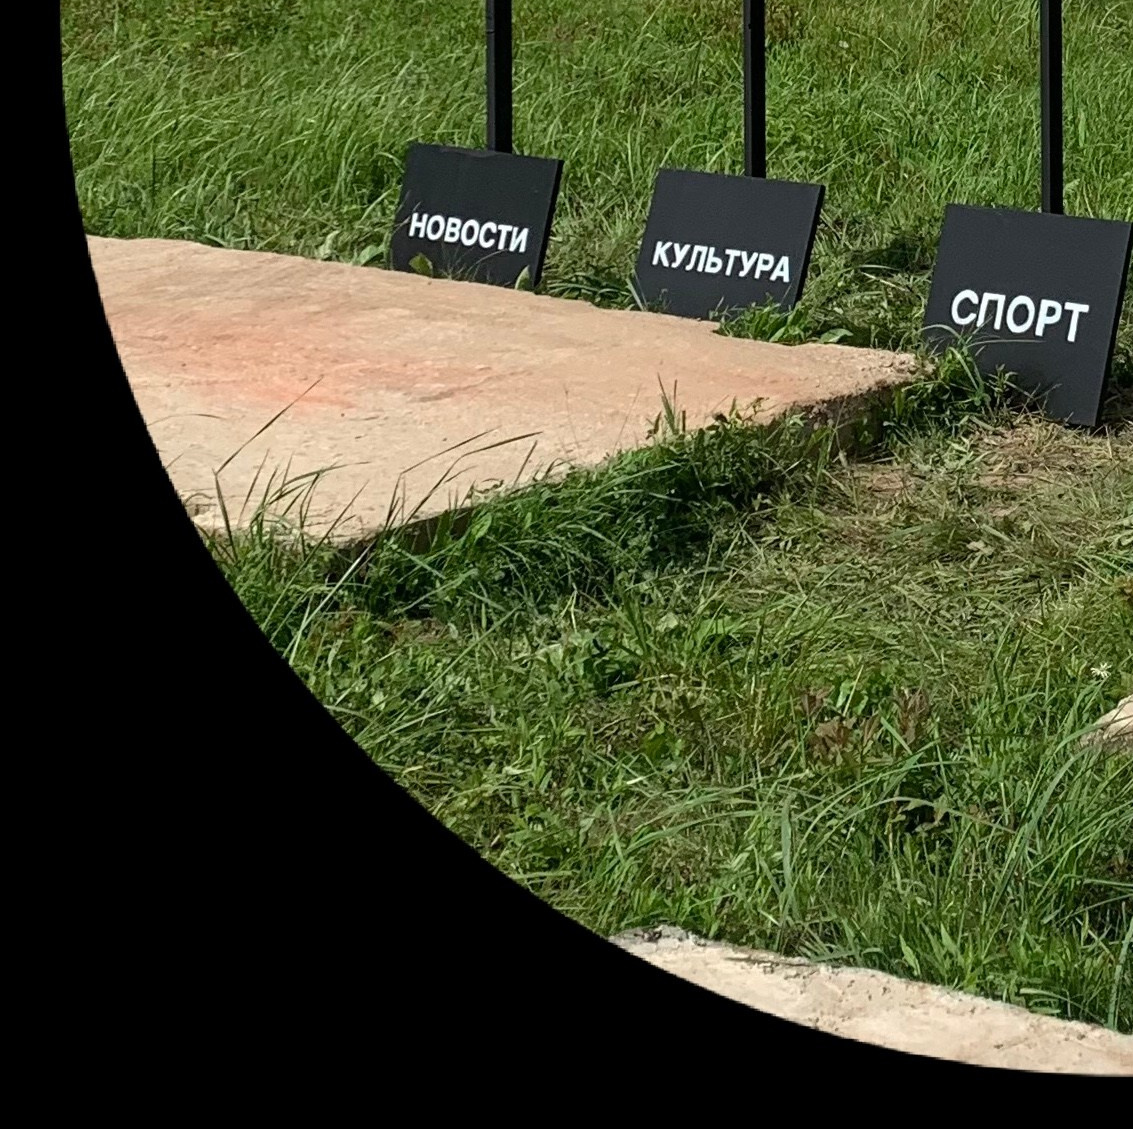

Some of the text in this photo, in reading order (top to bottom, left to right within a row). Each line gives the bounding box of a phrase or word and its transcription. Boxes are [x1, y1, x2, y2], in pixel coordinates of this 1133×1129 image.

[408, 212, 529, 253] НОВОСТИ
[651, 240, 790, 283] КУЛЬТУРА
[950, 288, 1090, 343] СПОРТ
